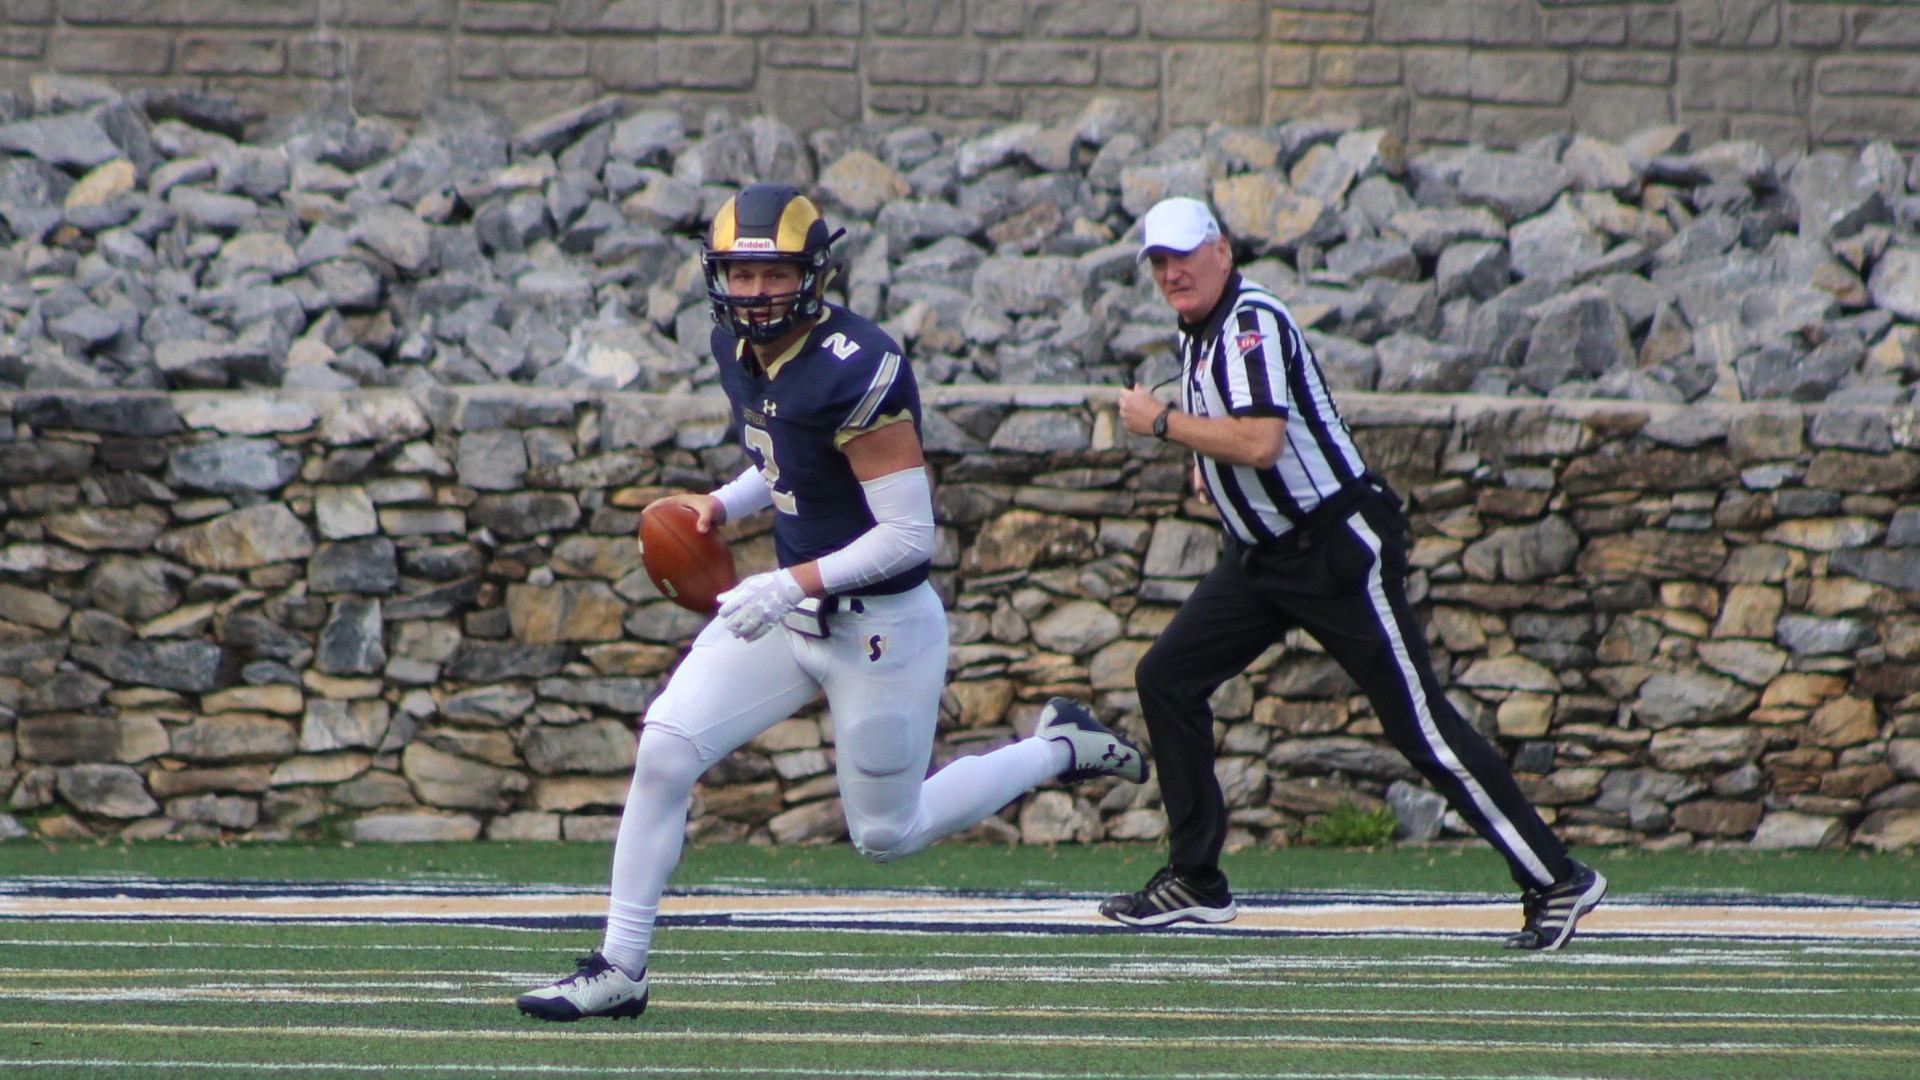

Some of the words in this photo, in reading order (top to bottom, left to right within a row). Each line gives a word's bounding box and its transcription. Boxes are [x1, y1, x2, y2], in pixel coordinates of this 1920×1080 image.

[737, 240, 770, 249] Riddell
[821, 332, 860, 360] 2
[744, 423, 799, 516] 2
